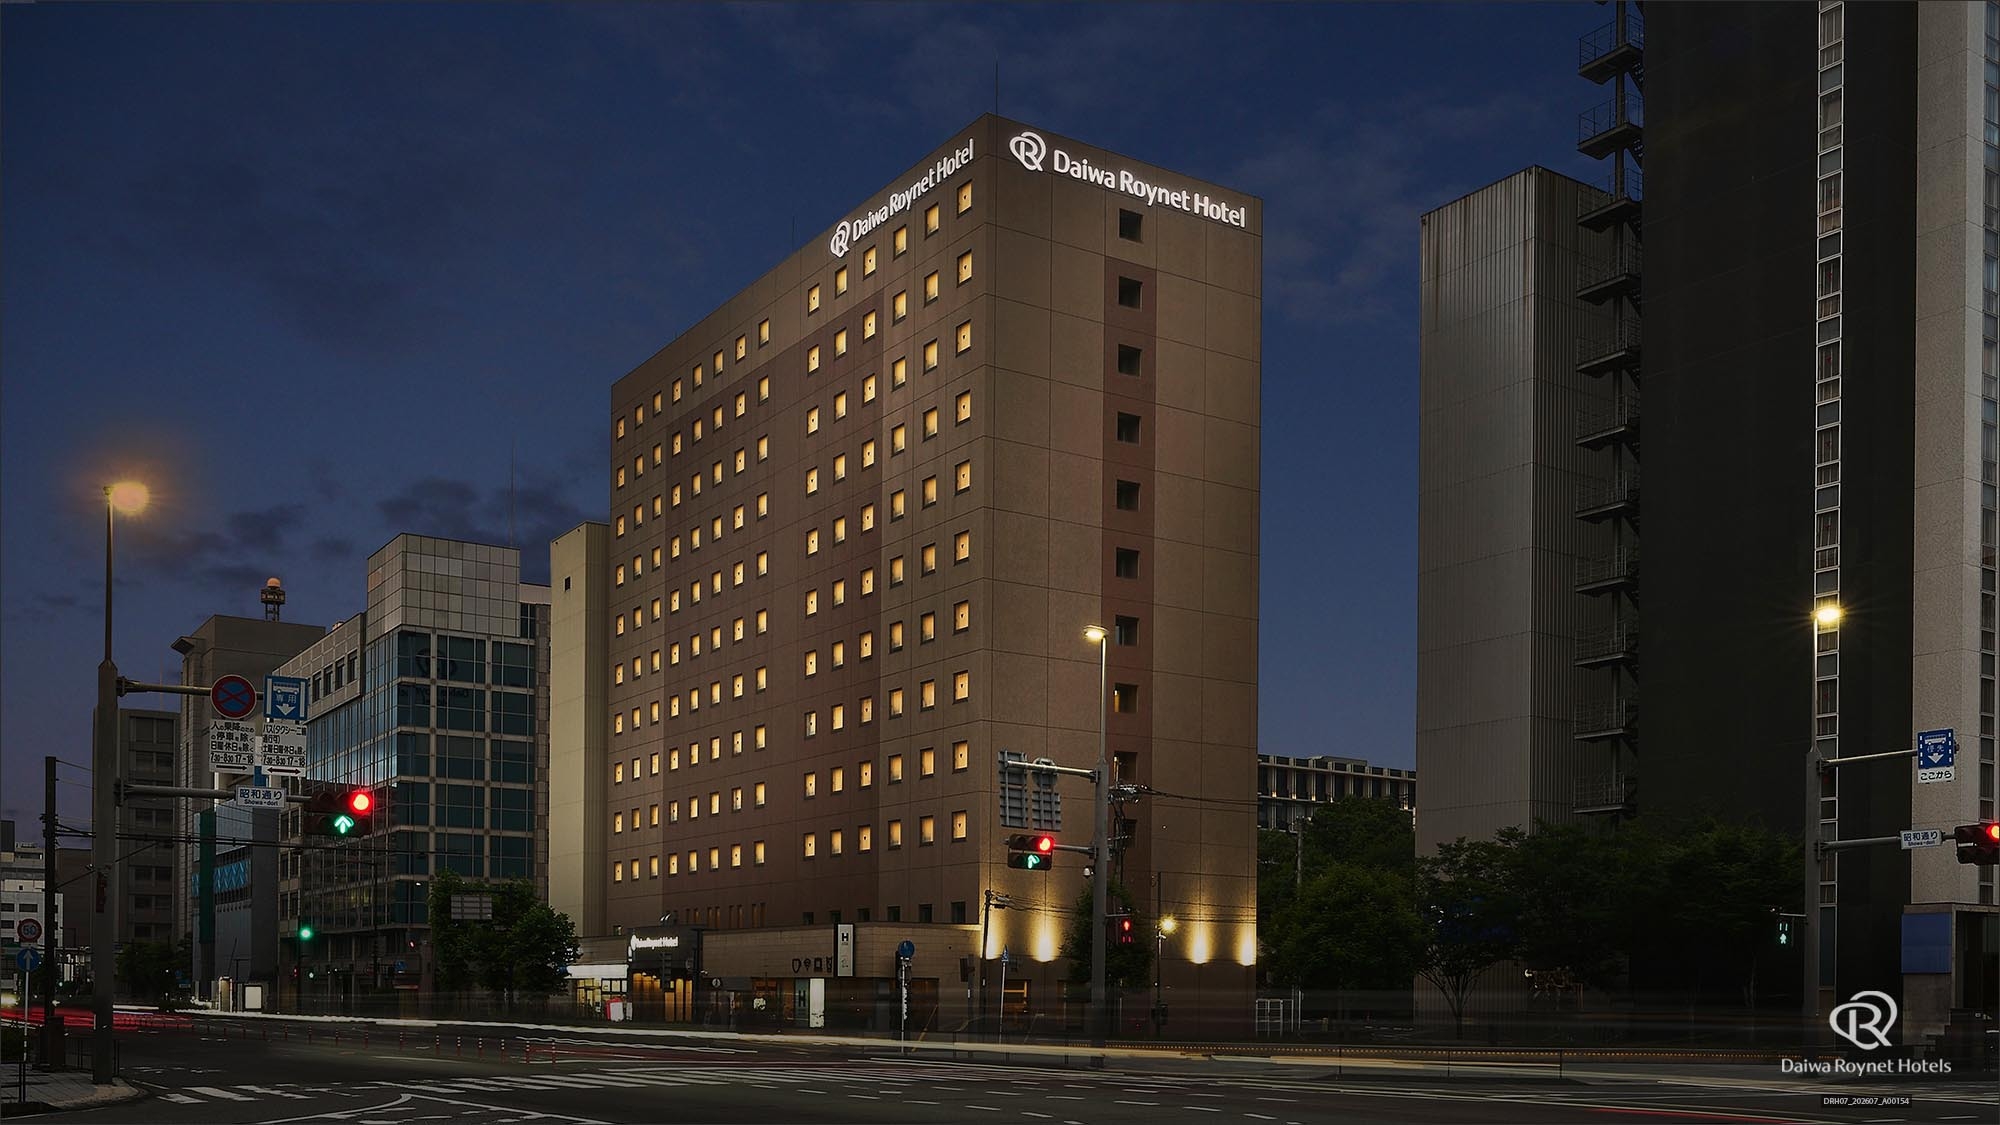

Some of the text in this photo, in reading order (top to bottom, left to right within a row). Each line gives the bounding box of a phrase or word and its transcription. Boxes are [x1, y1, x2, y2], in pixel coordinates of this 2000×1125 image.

[852, 205, 889, 242] Daiwa
[889, 168, 936, 216] Roynet
[936, 138, 975, 183] Hotel
[1053, 149, 1116, 189] Daiwa
[1119, 170, 1191, 212] Roynet
[1193, 192, 1246, 228] Hotel
[1920, 770, 1952, 780] ここから
[240, 789, 282, 800] 昭和通り
[1904, 831, 1938, 842] 昭和通り
[841, 932, 849, 941] H
